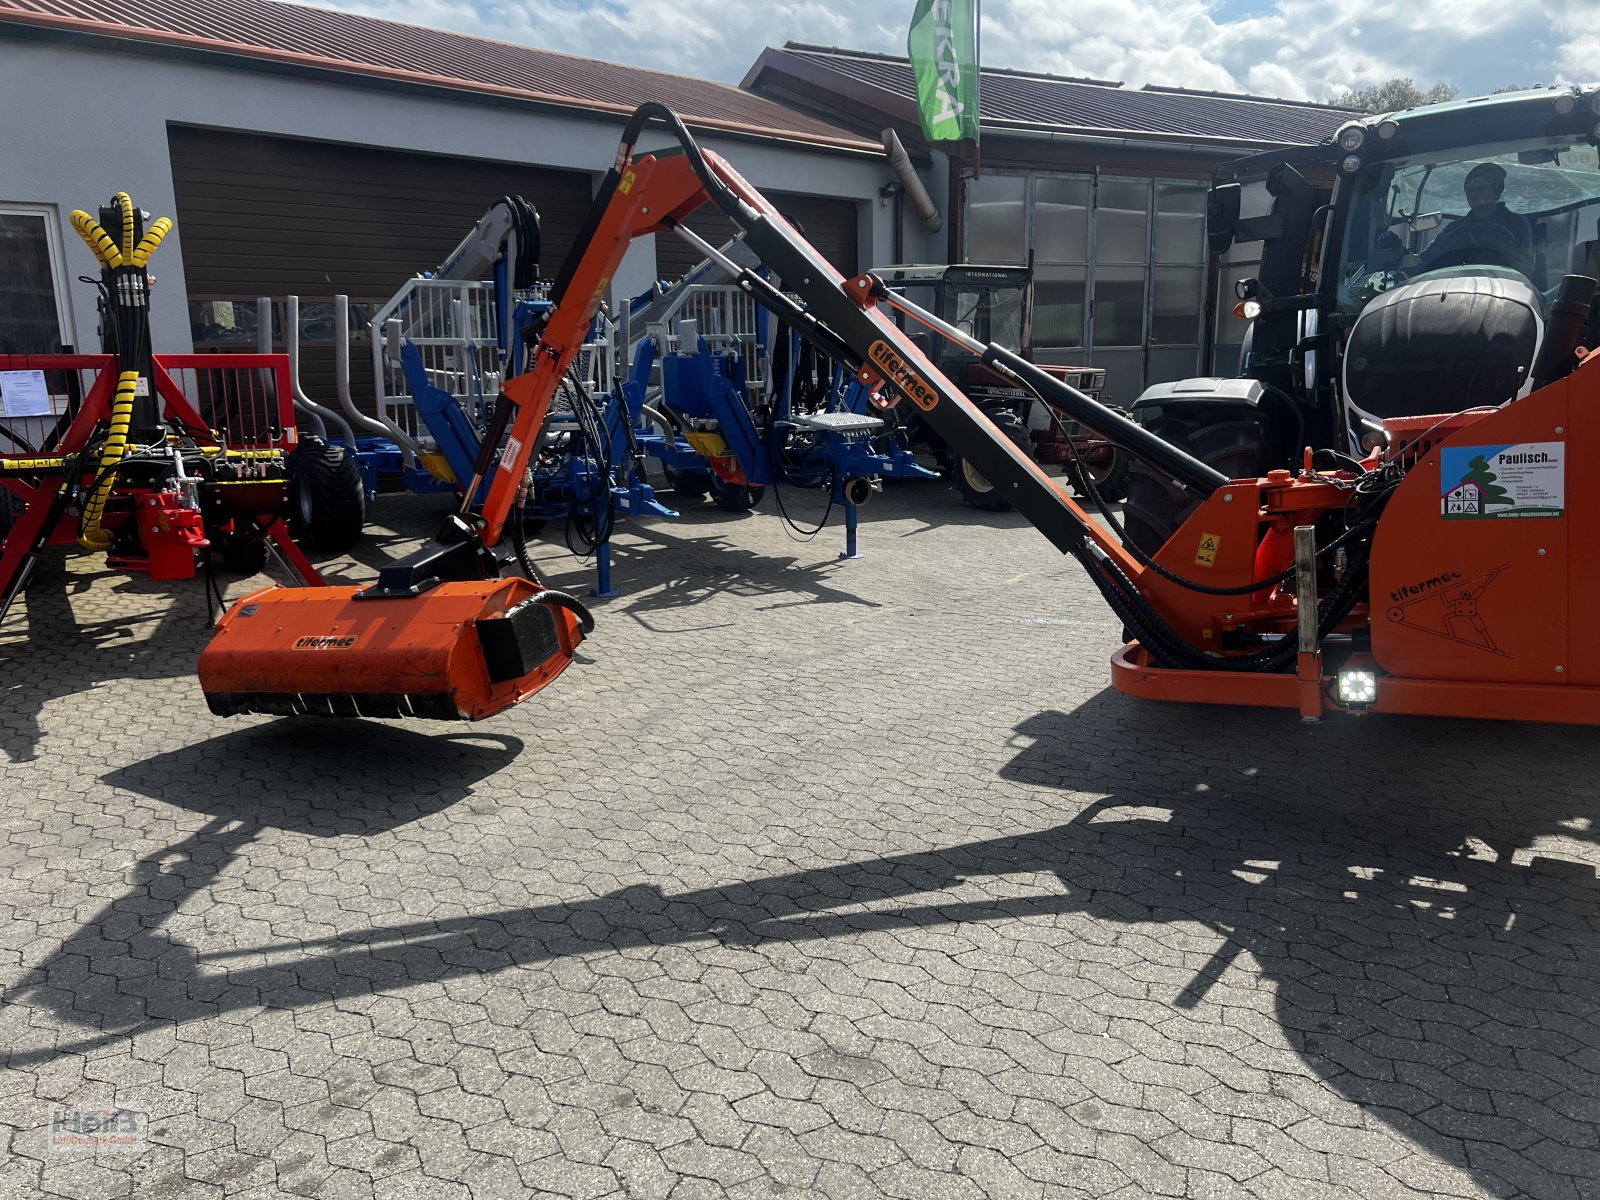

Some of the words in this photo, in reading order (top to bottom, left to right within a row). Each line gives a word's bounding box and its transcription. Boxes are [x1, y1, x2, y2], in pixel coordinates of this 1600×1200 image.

[873, 343, 935, 407] tifermec
[1499, 452, 1548, 465] Paulisch
[1390, 571, 1462, 601] tifermec
[296, 636, 354, 648] tifermec
